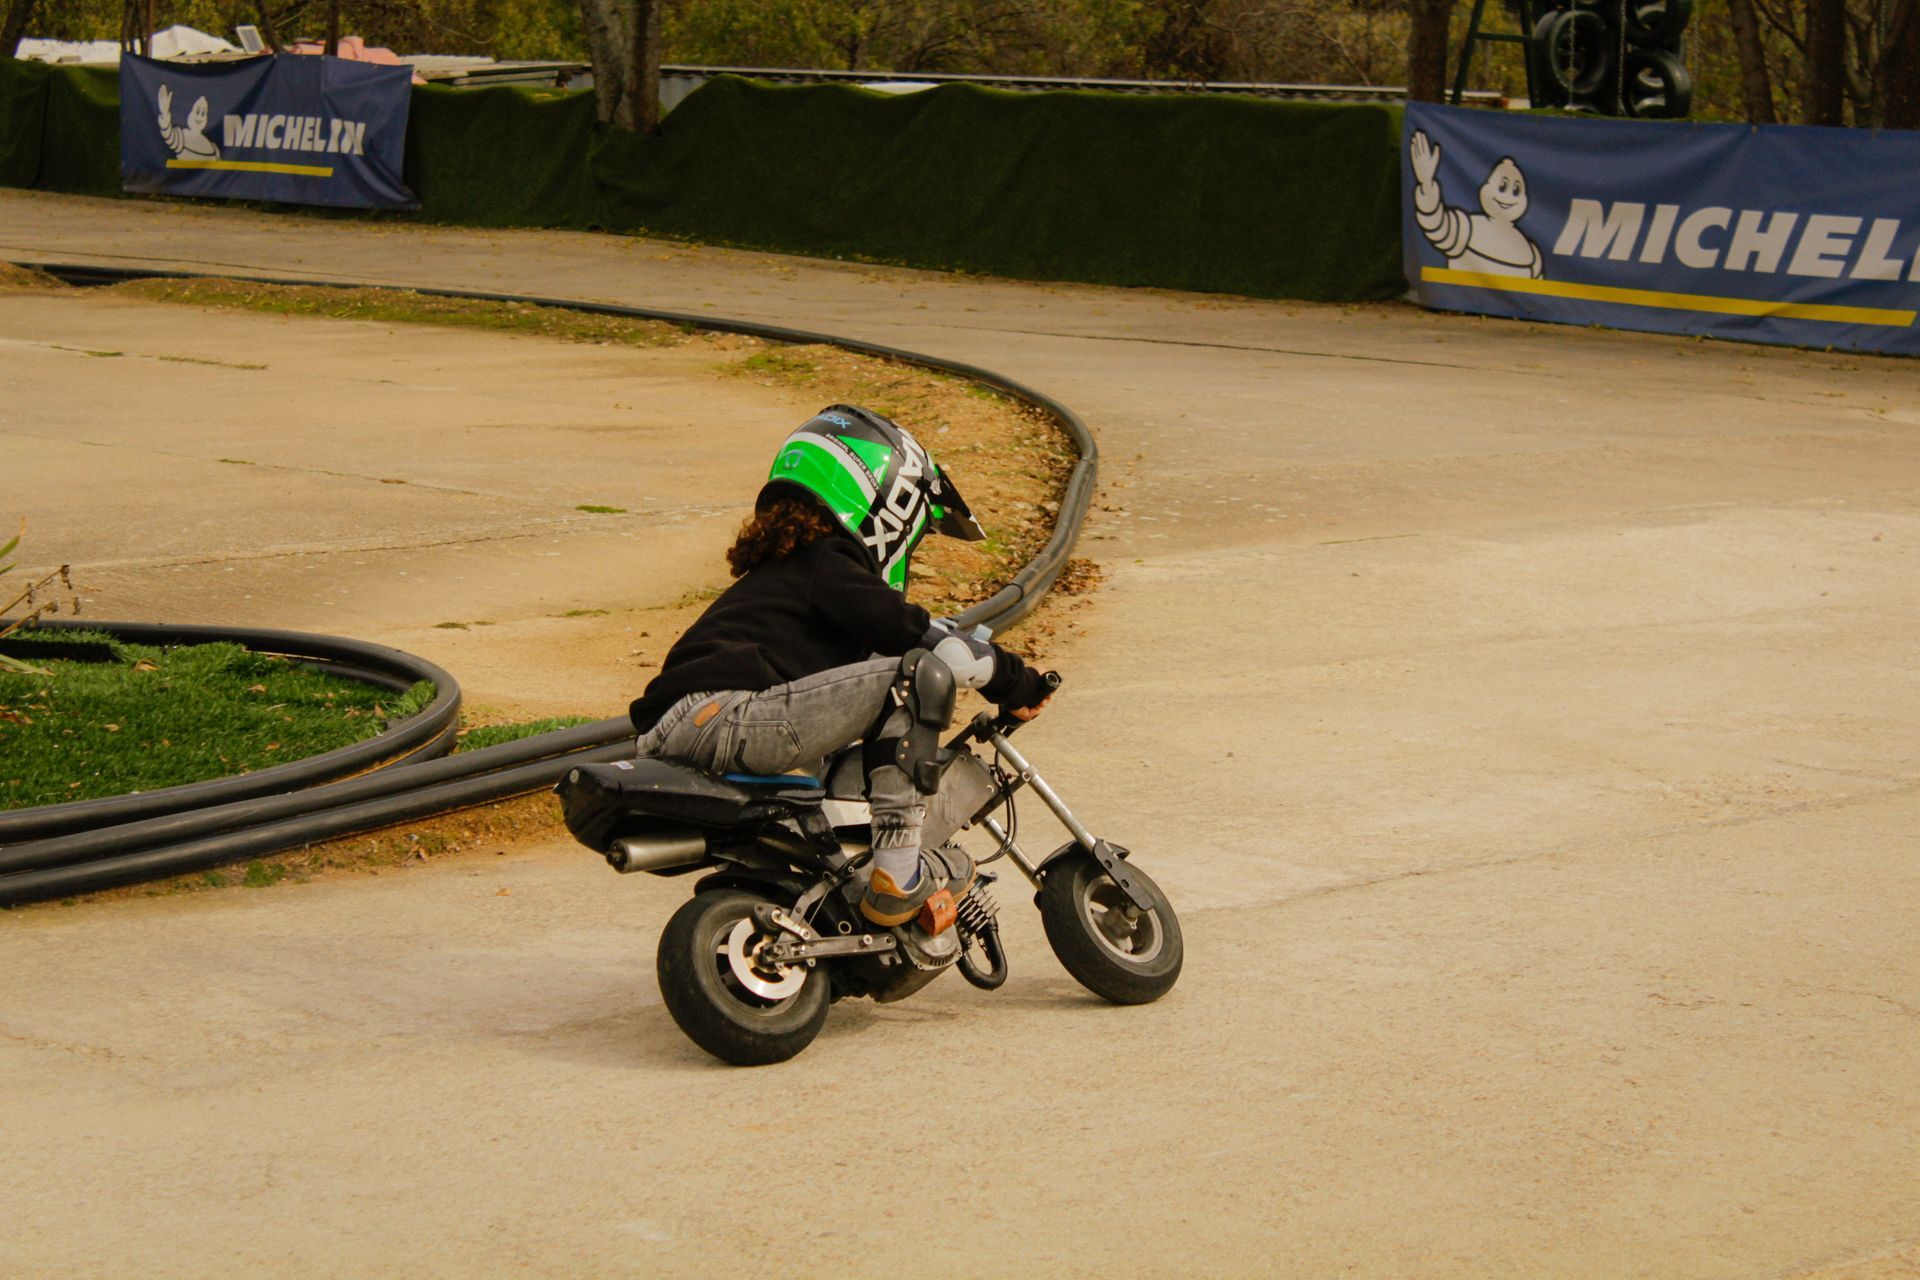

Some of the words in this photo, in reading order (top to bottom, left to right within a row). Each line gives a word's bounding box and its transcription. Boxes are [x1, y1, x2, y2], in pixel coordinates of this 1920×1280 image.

[223, 114, 366, 155] MICHELIN
[1552, 198, 1920, 282] MICHEL
[849, 451, 867, 471] SUPER
[865, 469, 880, 490] SPORT
